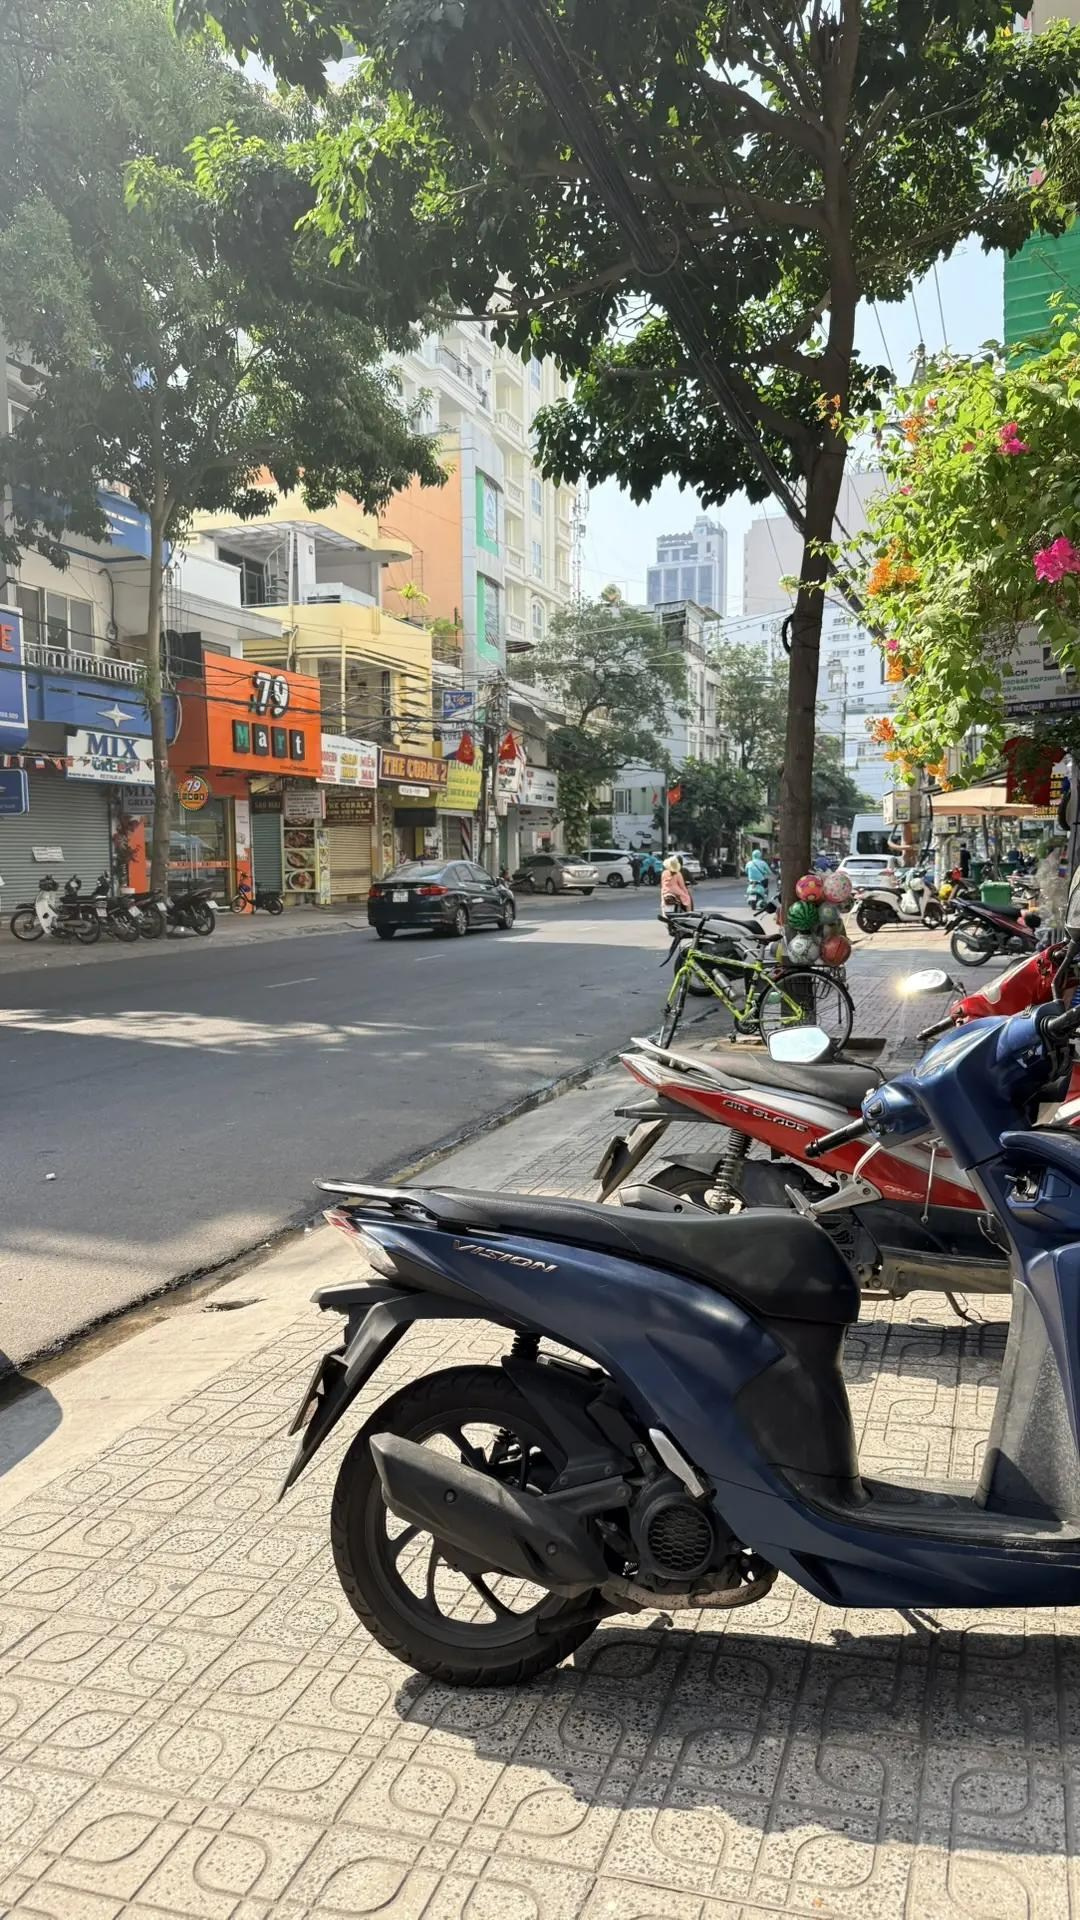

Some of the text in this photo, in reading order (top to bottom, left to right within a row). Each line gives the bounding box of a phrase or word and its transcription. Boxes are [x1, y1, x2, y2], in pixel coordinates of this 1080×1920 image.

[254, 671, 290, 717] 79
[86, 732, 140, 760] MIX
[236, 723, 303, 755] Mart
[383, 755, 406, 777] THE
[406, 758, 440, 781] CORAL
[440, 763, 448, 781] 2
[186, 779, 201, 792] 79
[721, 1100, 810, 1133] AIR BLADE
[453, 1239, 559, 1274] VISION
